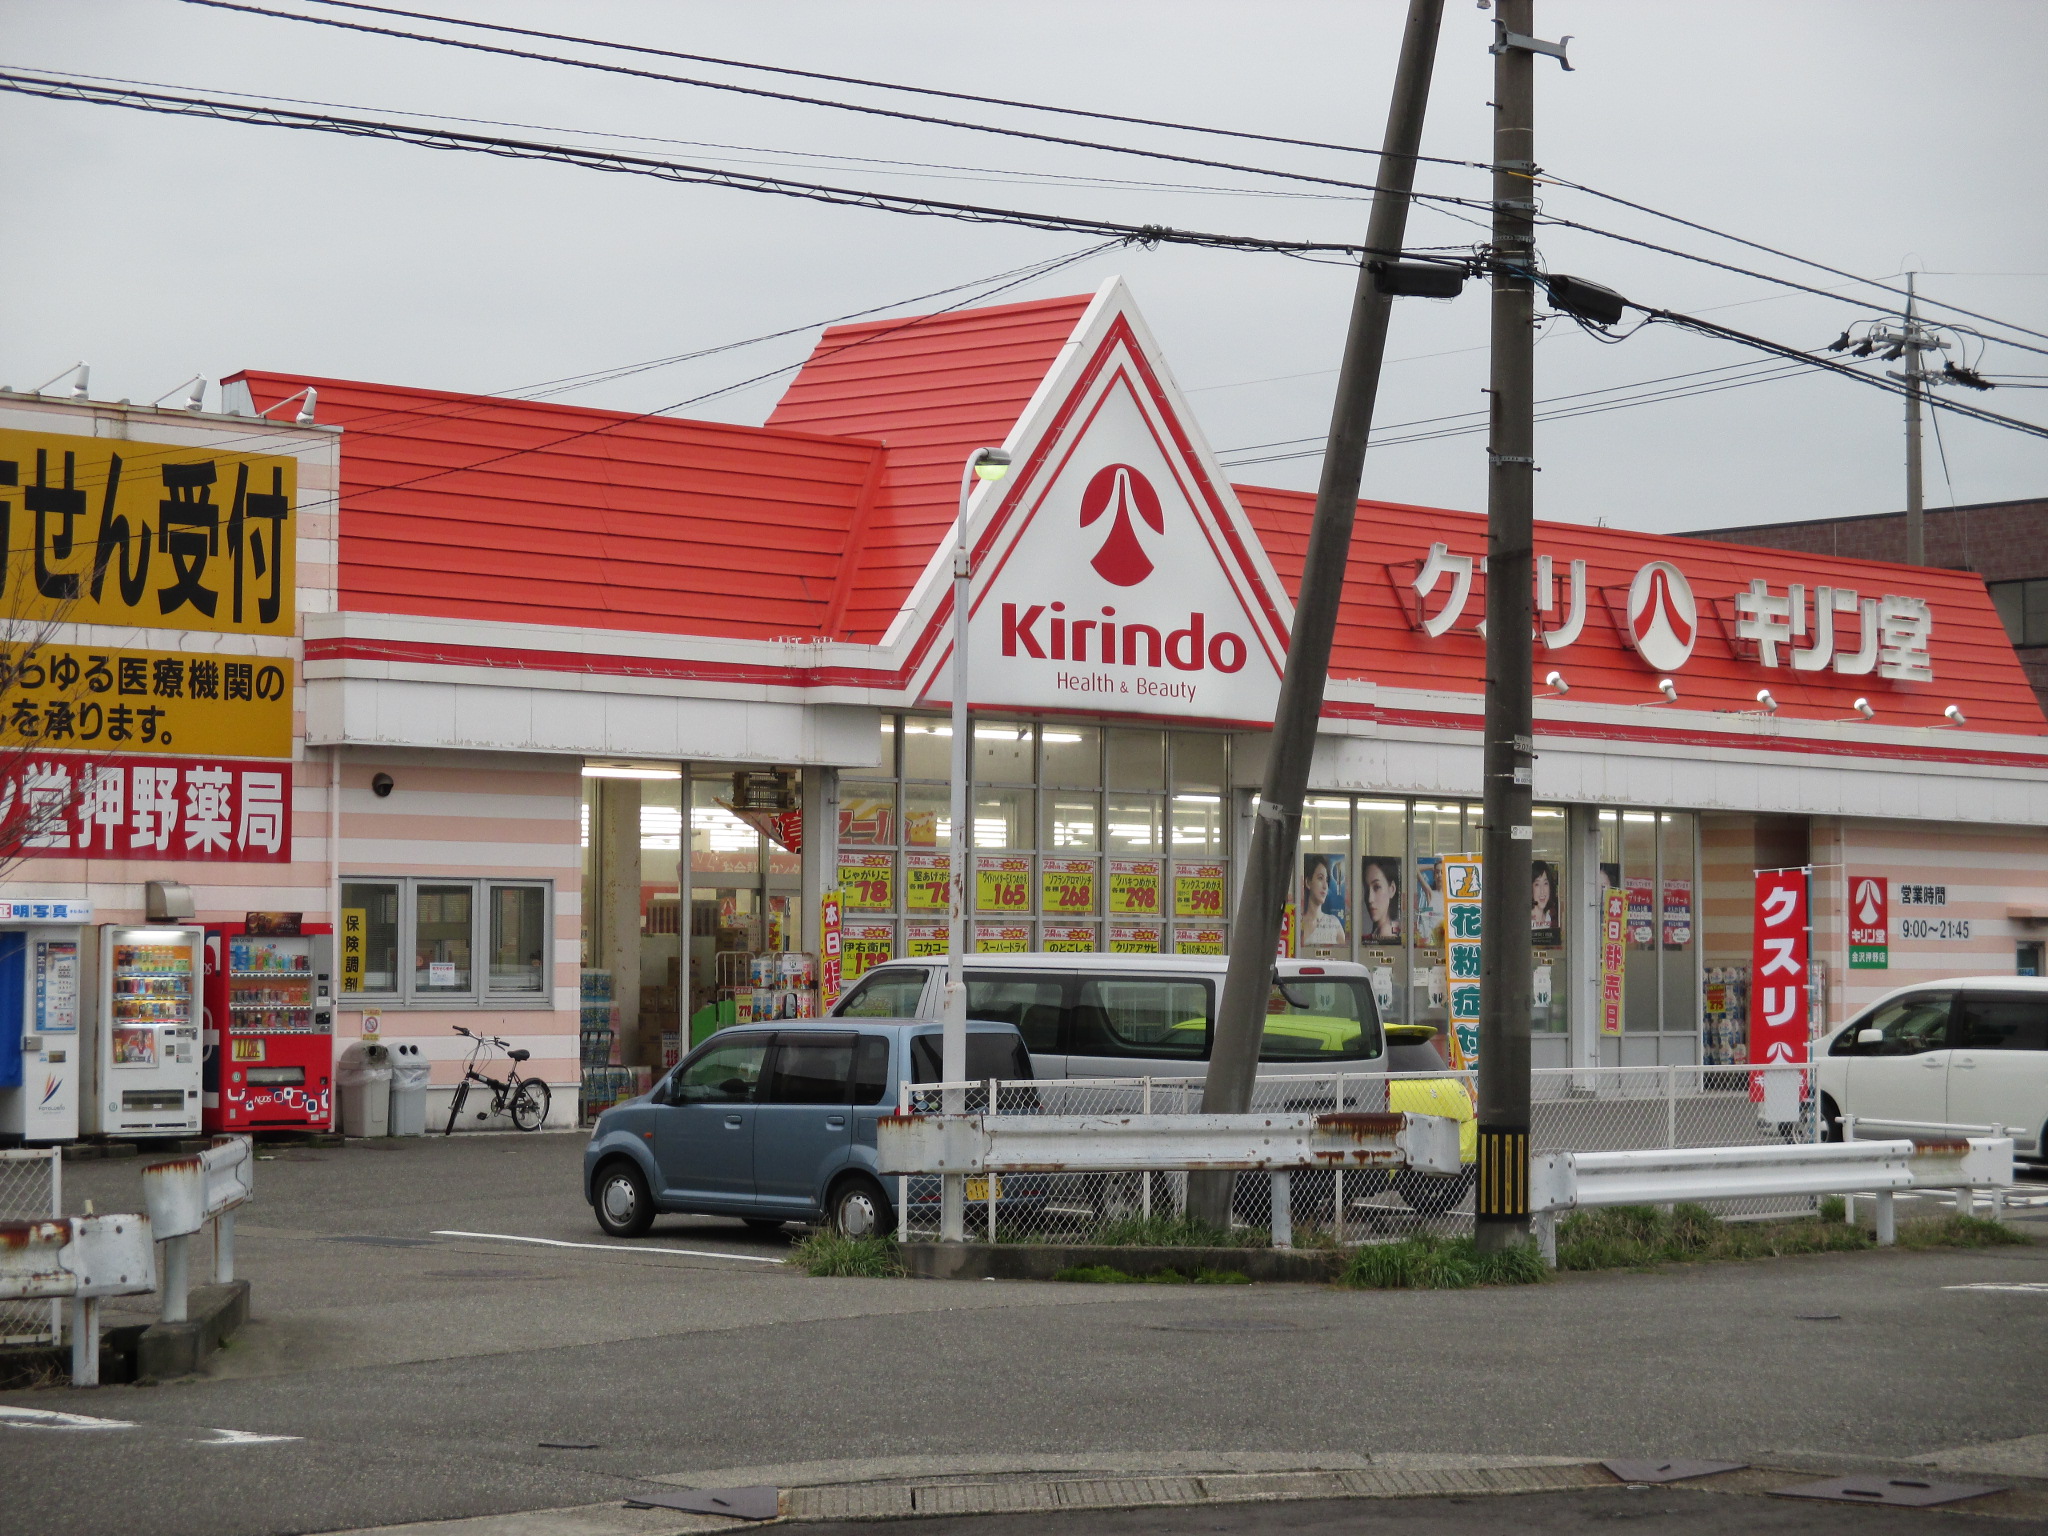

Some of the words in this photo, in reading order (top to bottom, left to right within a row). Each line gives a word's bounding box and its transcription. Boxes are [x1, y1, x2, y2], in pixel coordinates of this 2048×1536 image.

[0, 448, 288, 624] せん受付
[1411, 541, 1587, 649] クリ
[1001, 600, 1247, 673] Kirindo
[1735, 578, 1932, 683] キリン堂
[1057, 671, 1114, 693] Health
[1119, 681, 1129, 694] &
[1136, 676, 1197, 703] Beauty
[0, 698, 172, 745] を承ります。
[842, 869, 889, 880] じゃがりこ
[854, 880, 887, 902] 78
[994, 884, 1025, 905] 165
[1059, 886, 1090, 906] 268
[1125, 887, 1155, 908] 298
[1191, 890, 1220, 910] 598
[1901, 885, 1946, 905] 営業時間
[1851, 929, 1886, 944] キリン堂
[345, 915, 359, 992] 保険調剤
[824, 904, 841, 1012] 本日特
[844, 942, 890, 953] 伊右衛門
[982, 942, 1027, 953] スーパードライ
[1760, 886, 1801, 1027] クスリ
[1852, 951, 1886, 963] 金沢押野店
[739, 1005, 752, 1017] 278
[1709, 1001, 1724, 1010] 275
